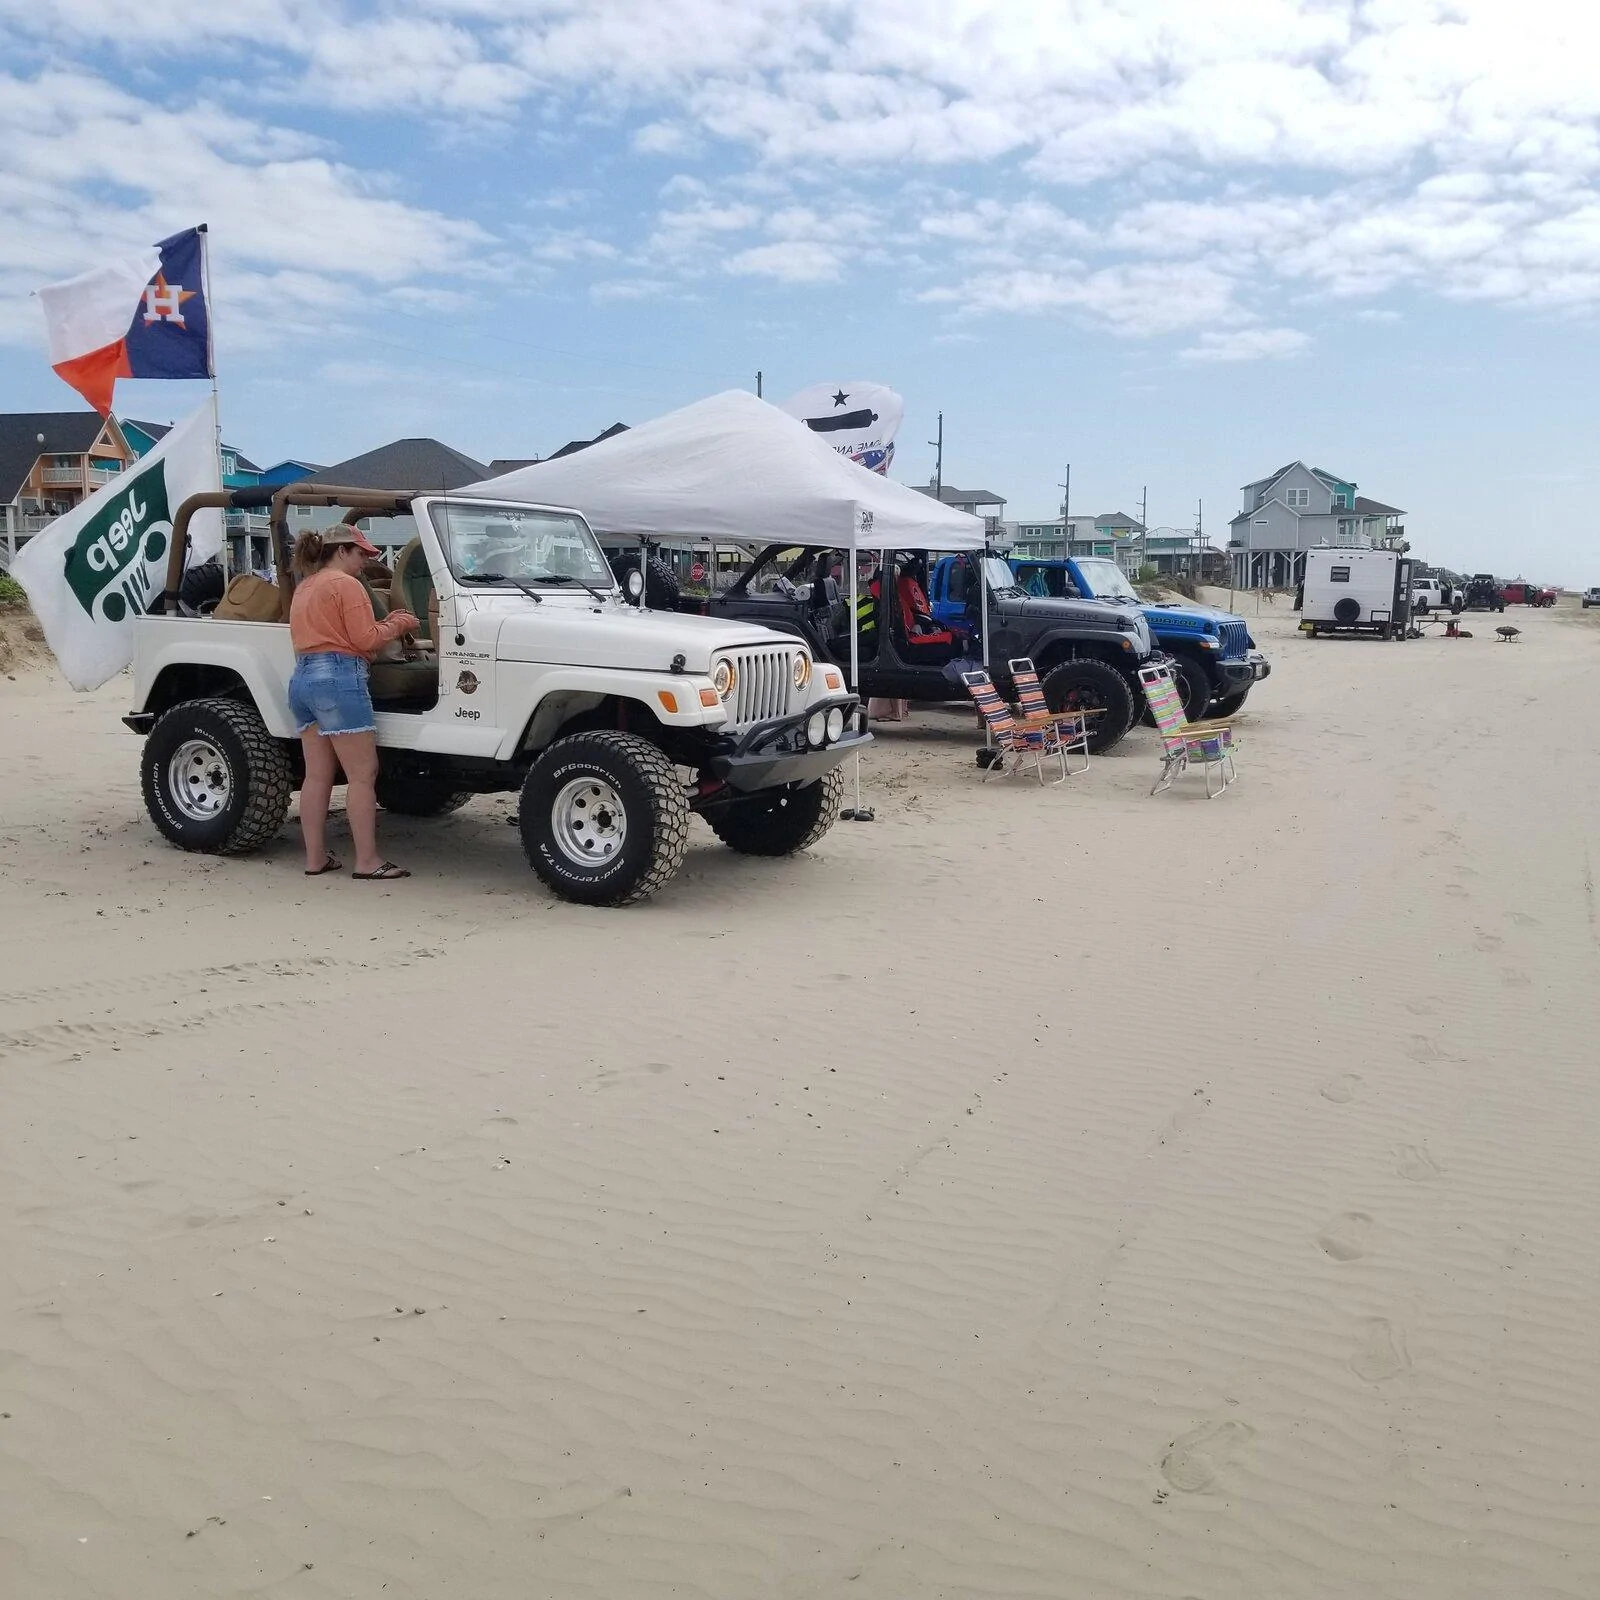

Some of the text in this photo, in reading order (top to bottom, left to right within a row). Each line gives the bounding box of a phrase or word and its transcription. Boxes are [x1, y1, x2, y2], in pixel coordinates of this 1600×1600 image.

[143, 285, 184, 321] H
[1027, 608, 1099, 620] RUBICON
[445, 651, 490, 659] WRANGLER
[455, 707, 480, 721] Jeep
[553, 763, 621, 788] BFGoodrich
[153, 762, 183, 830] BFGoodrich
[540, 843, 625, 882] Mud-Terrain T/A
